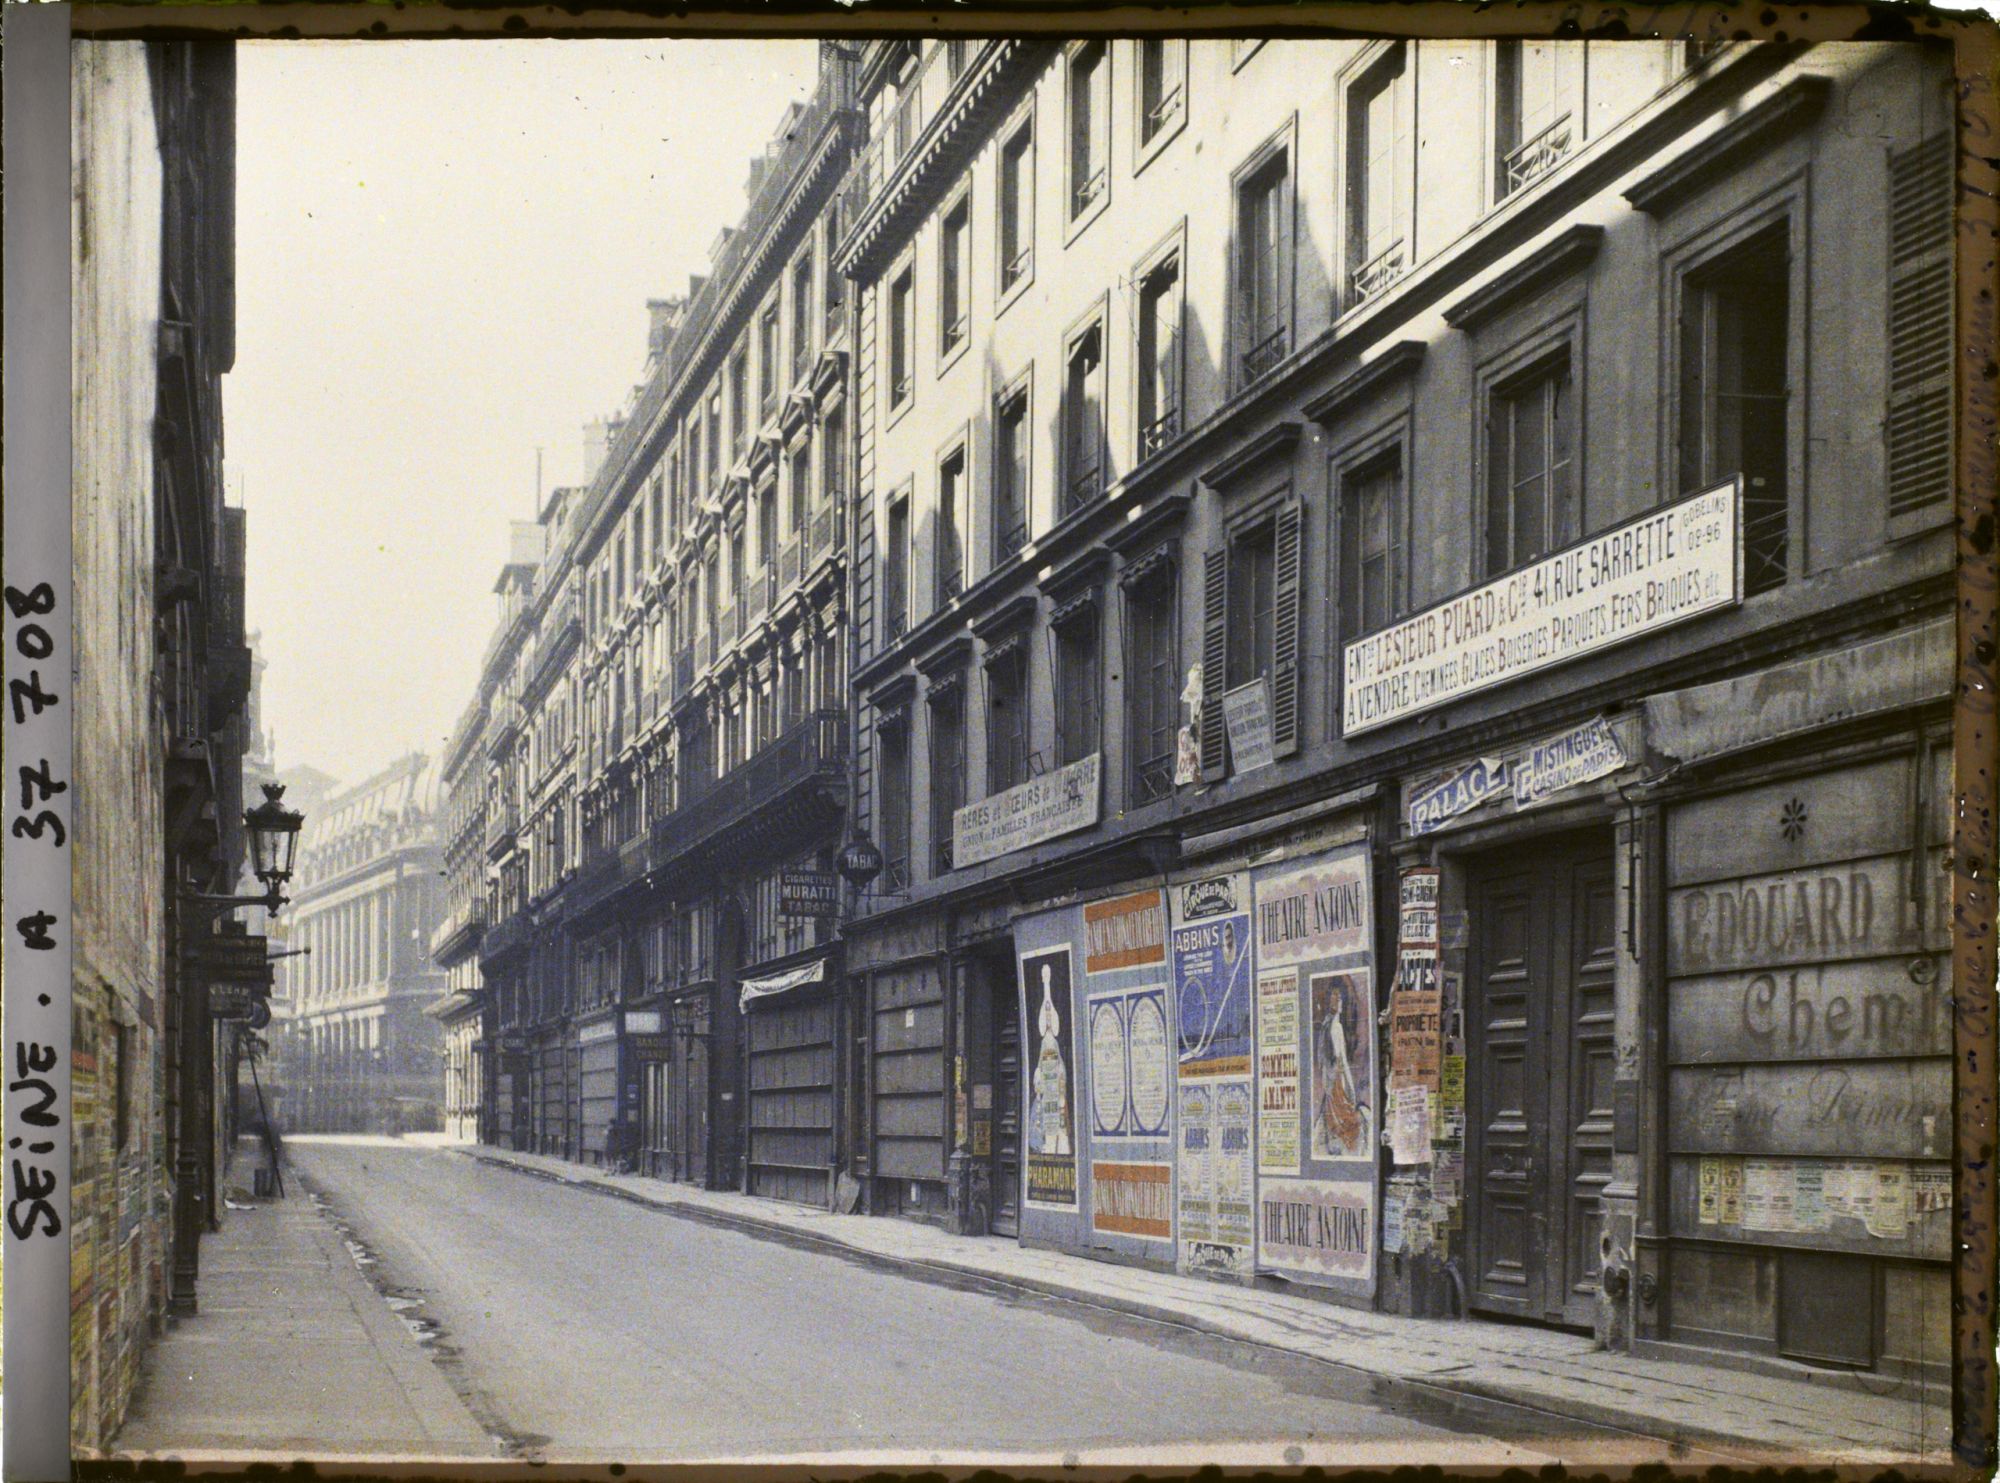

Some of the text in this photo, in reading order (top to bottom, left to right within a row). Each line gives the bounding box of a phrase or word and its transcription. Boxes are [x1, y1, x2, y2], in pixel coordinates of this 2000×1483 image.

[1376, 615, 1436, 675] LESIEUR
[1442, 590, 1495, 648] PUARD
[1499, 597, 1506, 627] &
[1555, 550, 1584, 602] RUE
[1590, 513, 1675, 588] SARRETTE
[5, 583, 60, 724] 708
[1347, 686, 1356, 727] A
[1358, 670, 1412, 723] VENDRE
[1462, 645, 1496, 685] GLACES
[1499, 625, 1548, 673] BOISERIES
[1611, 589, 1642, 633] FERS
[1646, 568, 1701, 622] BRIQUES
[1533, 768, 1570, 797] CASINO
[1582, 746, 1618, 777] PARIS
[11, 757, 68, 847] 37
[1414, 765, 1505, 832] PALACE
[784, 874, 833, 886] CIGARETTES
[845, 854, 879, 870] TABAC
[782, 885, 836, 900] MURATTI
[787, 901, 830, 914] TABAC
[1259, 880, 1363, 946] THEATRE ANTOINE
[15, 909, 58, 951] A
[1175, 925, 1220, 954] ABBINS
[1261, 1052, 1297, 1080] SOMMEIL
[1263, 1085, 1296, 1111] AMANTS
[1028, 1166, 1076, 1191] PHARAMOND
[1262, 1200, 1312, 1248] THEATRE
[1316, 1205, 1368, 1255] ANTOINE
